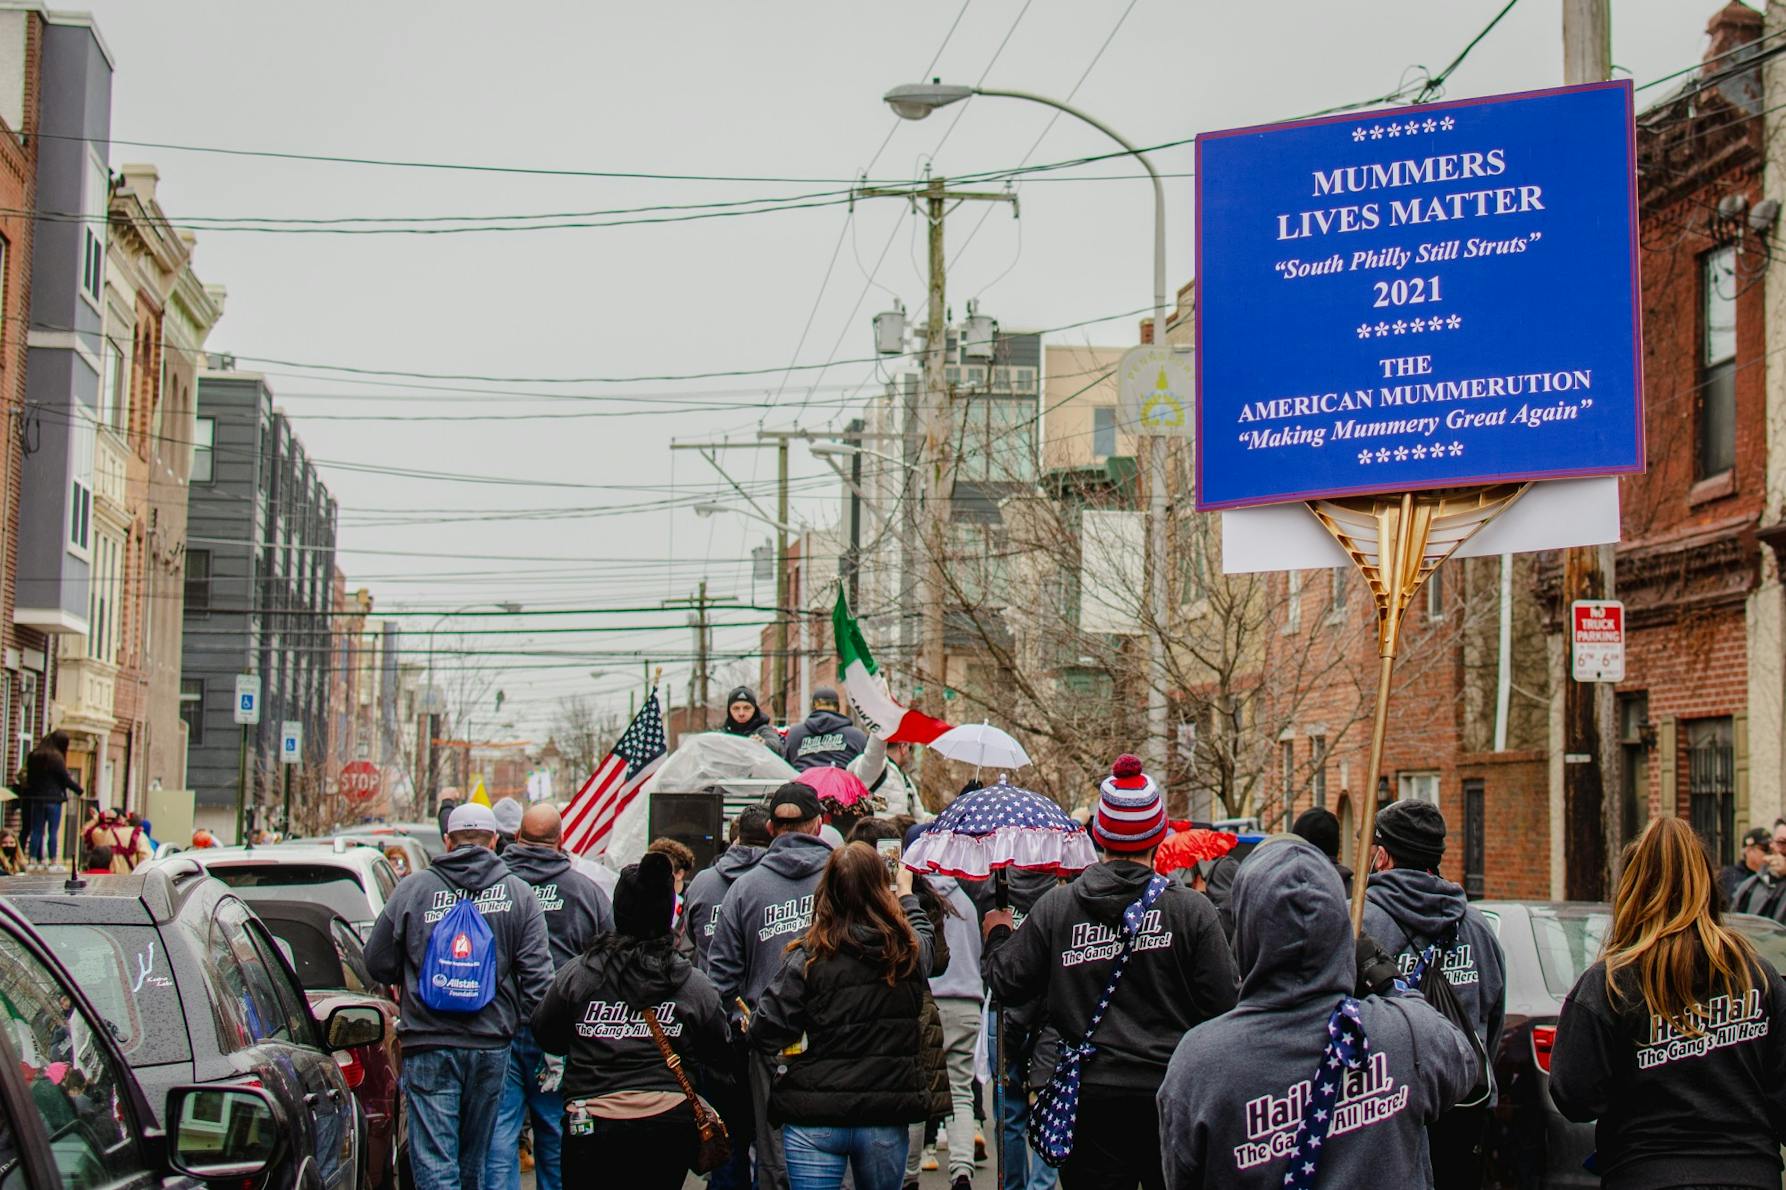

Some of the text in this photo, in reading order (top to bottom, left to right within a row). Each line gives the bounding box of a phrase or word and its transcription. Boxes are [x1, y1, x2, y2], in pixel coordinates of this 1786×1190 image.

[1312, 149, 1505, 197] MUMMERS
[1276, 185, 1546, 241] LIVES MATTER
[1275, 232, 1542, 280] “South Philly Still Struts”
[1372, 275, 1443, 308] 2021
[1379, 355, 1433, 379] THE
[1237, 369, 1592, 423] AMERICAN MUMMERUTION
[1238, 398, 1594, 450] “Making Mummery Great Again”
[1576, 630, 1620, 642] PARKING
[1581, 618, 1616, 631] TRUCK
[340, 772, 380, 791] STOP
[764, 900, 799, 926] Hail,
[759, 926, 775, 942] The
[1062, 949, 1084, 967] The
[1138, 931, 1173, 951] Here!
[584, 1001, 629, 1023] Hail,
[576, 1023, 594, 1037] The
[631, 1023, 650, 1037] All
[1637, 1048, 1668, 1069] The
[1715, 1024, 1738, 1048] All
[1338, 1052, 1394, 1107] ail,
[1234, 1142, 1272, 1169] The
[1332, 1103, 1362, 1136] All
[1362, 1085, 1409, 1124] Here!
